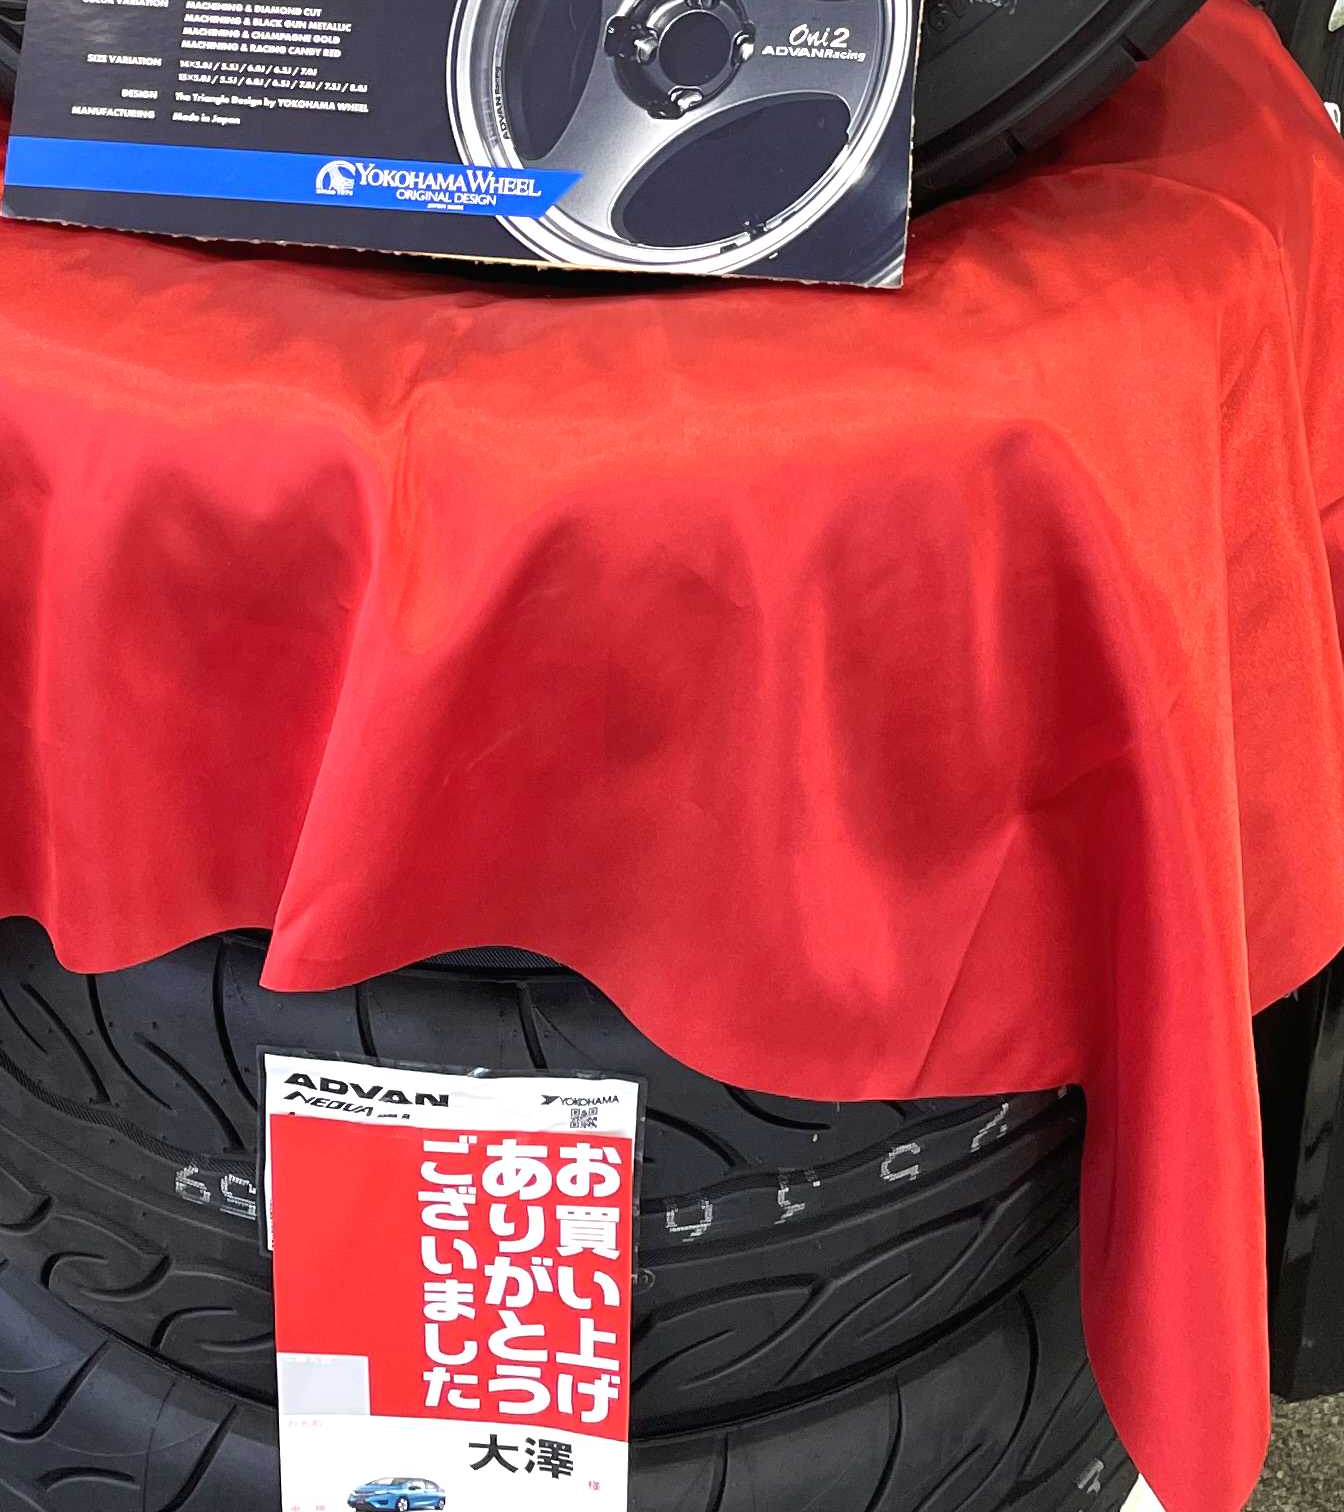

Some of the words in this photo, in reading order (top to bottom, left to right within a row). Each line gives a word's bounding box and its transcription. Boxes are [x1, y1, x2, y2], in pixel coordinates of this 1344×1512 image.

[186, 1, 243, 13] MACHINING
[253, 5, 302, 16] DIAMOND
[303, 7, 322, 17] CUT
[184, 13, 242, 25] MACHINING
[252, 18, 283, 28] BLACK
[284, 21, 307, 30] GUN
[308, 22, 352, 33] METALLIC
[182, 27, 240, 38] MACHINING
[251, 31, 312, 42] CHAMPAGNE
[312, 34, 341, 44] GOLD
[181, 40, 239, 52] MACHINING
[249, 44, 287, 55] RACING
[288, 46, 322, 57] CANDY
[322, 48, 342, 58] RED
[87, 53, 108, 64] SIZE
[108, 55, 162, 66] VARIATION
[175, 91, 192, 102] The
[192, 92, 230, 106] Triangle
[231, 96, 263, 108] Design
[277, 98, 336, 110] YOKOHAMA
[337, 102, 369, 113] WHEEL
[71, 106, 156, 119] MANUFACTURING
[172, 112, 200, 123] Made
[211, 115, 241, 127] Japan
[396, 188, 452, 204] ORIGINAL
[453, 192, 497, 206] DESIGN
[283, 1073, 449, 1108] ADVAN
[559, 1095, 620, 1107] YOKOHAMA
[418, 1135, 482, 1409] ございました
[482, 1138, 554, 1415] ありがとう
[556, 1142, 622, 1424] お買い上げ
[468, 1433, 575, 1480] 大澤
